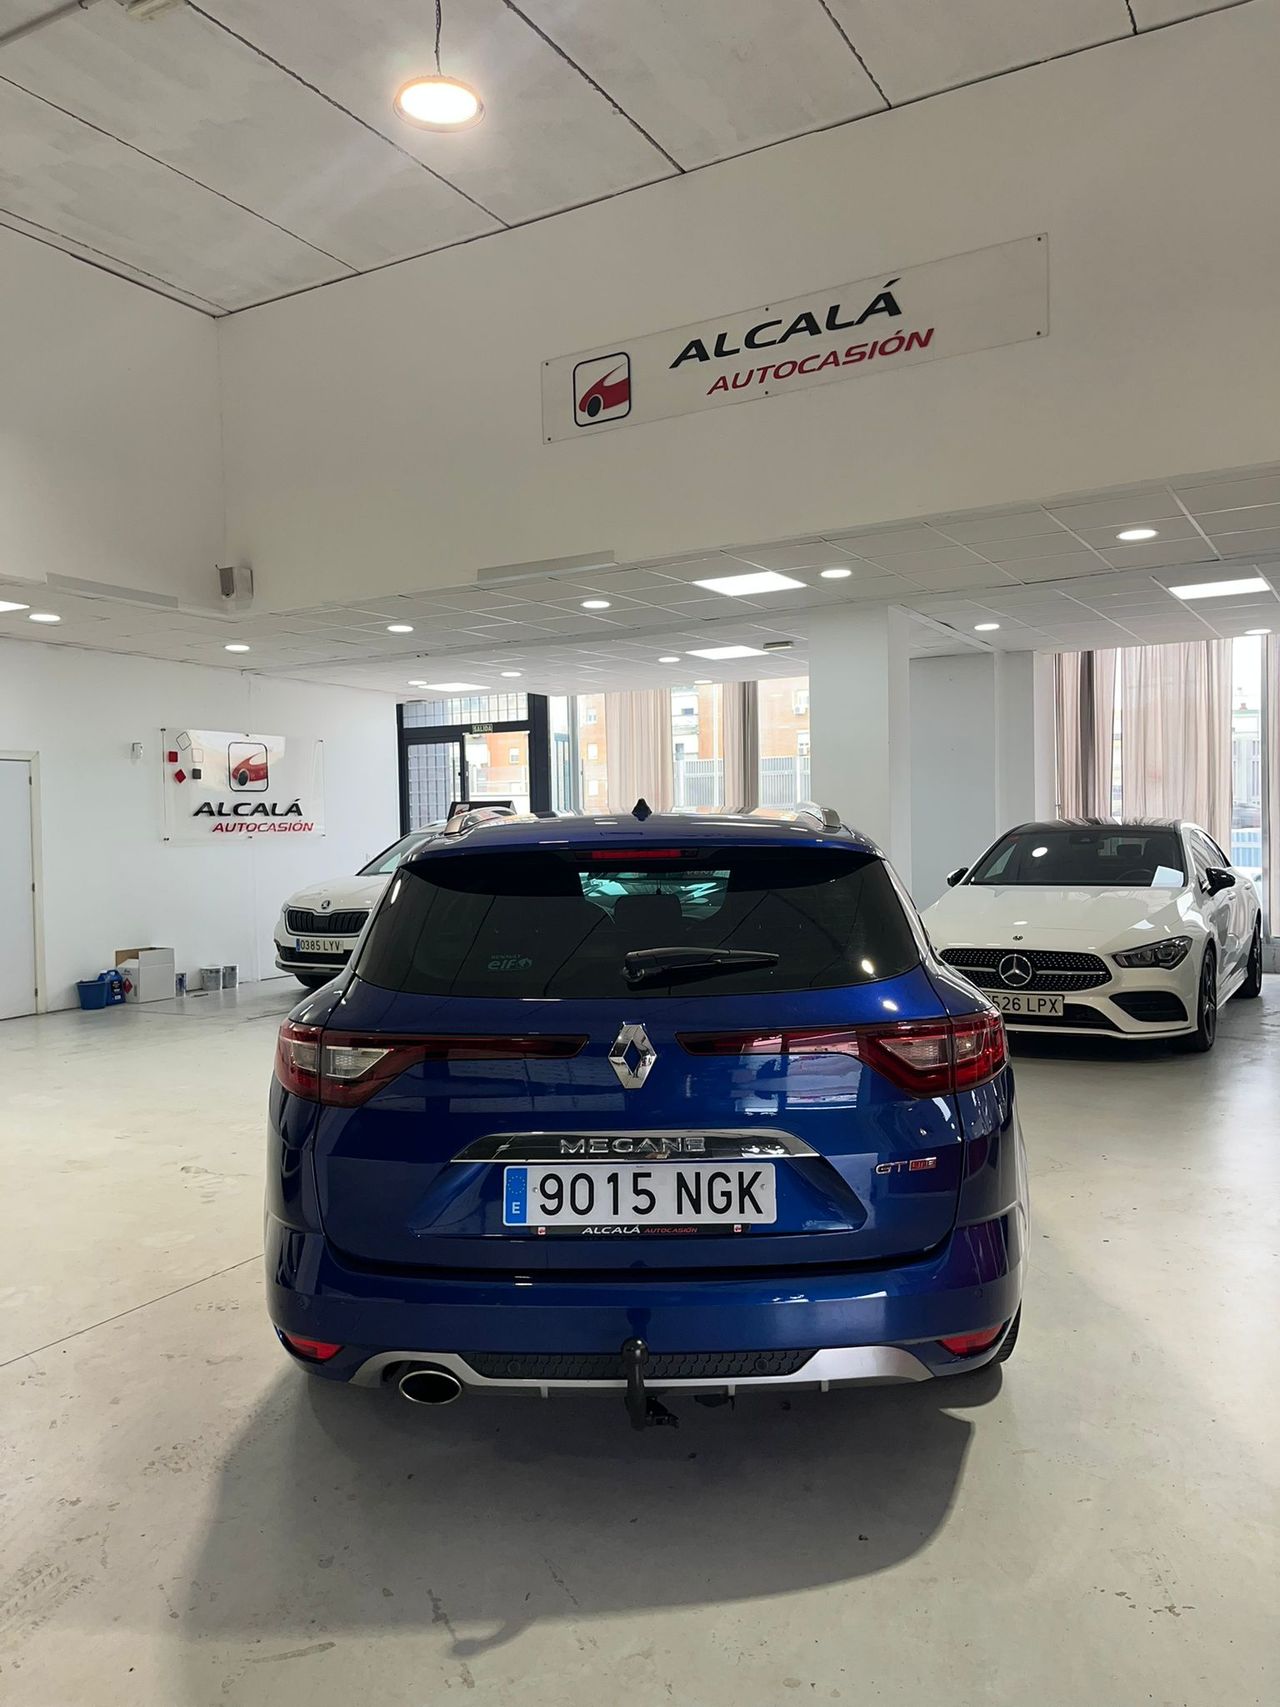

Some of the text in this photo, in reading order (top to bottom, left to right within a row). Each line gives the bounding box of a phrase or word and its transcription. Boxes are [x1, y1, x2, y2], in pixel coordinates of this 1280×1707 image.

[669, 278, 902, 369] ALCALÁ
[707, 328, 935, 395] AUTOCASIÓN
[193, 799, 303, 817] ALCALÁ
[212, 820, 314, 832] AUTOCASIÓN
[300, 940, 341, 951] 0385 LYV
[488, 959, 517, 970] elf
[987, 995, 1058, 1013] 526 LPX
[560, 1137, 706, 1154] MEGANE
[875, 1160, 908, 1175] GT
[539, 1171, 764, 1216] 9015 NGK
[511, 1201, 521, 1214] E
[582, 1224, 699, 1235] ALCALÁ AUTOCASIÓN
